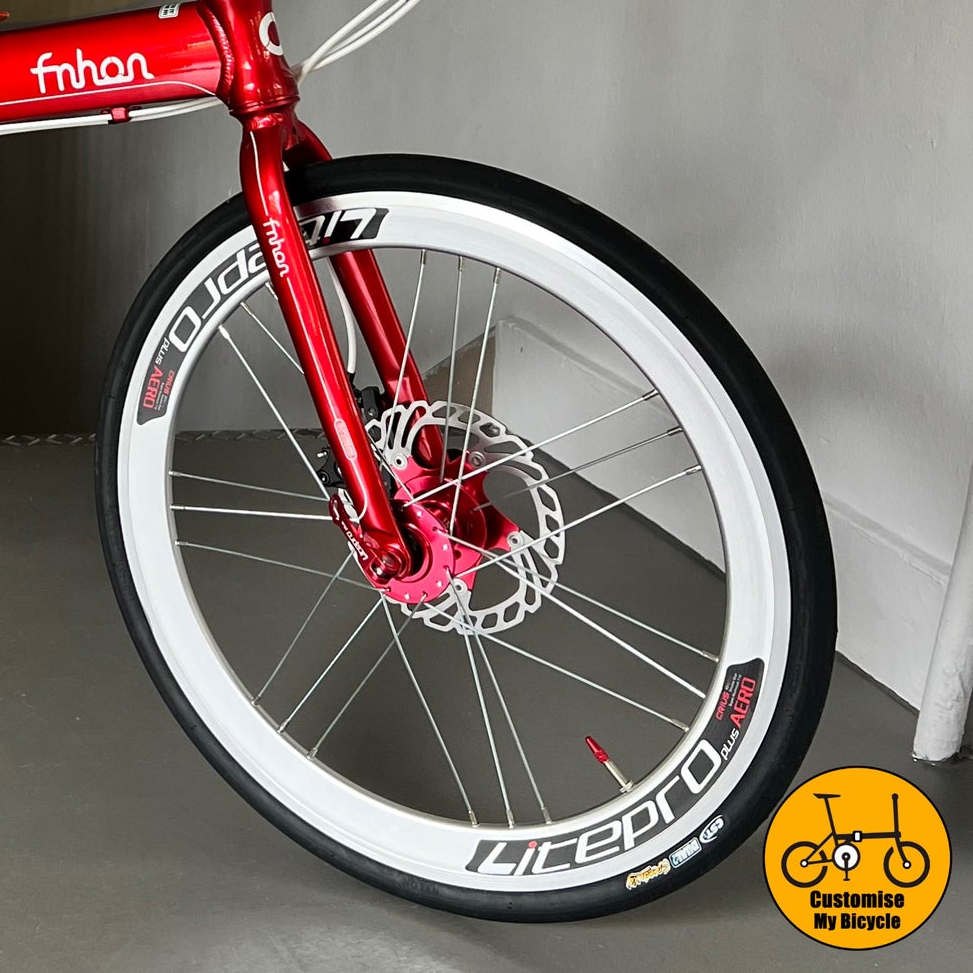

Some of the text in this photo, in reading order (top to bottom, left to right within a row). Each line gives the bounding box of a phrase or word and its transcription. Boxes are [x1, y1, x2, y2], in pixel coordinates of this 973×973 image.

[30, 48, 155, 93] fnhon
[263, 217, 289, 279] fnhon
[155, 338, 170, 365] plus
[143, 365, 162, 409] AERO
[478, 739, 722, 876] Litepro
[721, 728, 739, 760] plus
[730, 677, 756, 728] AERO
